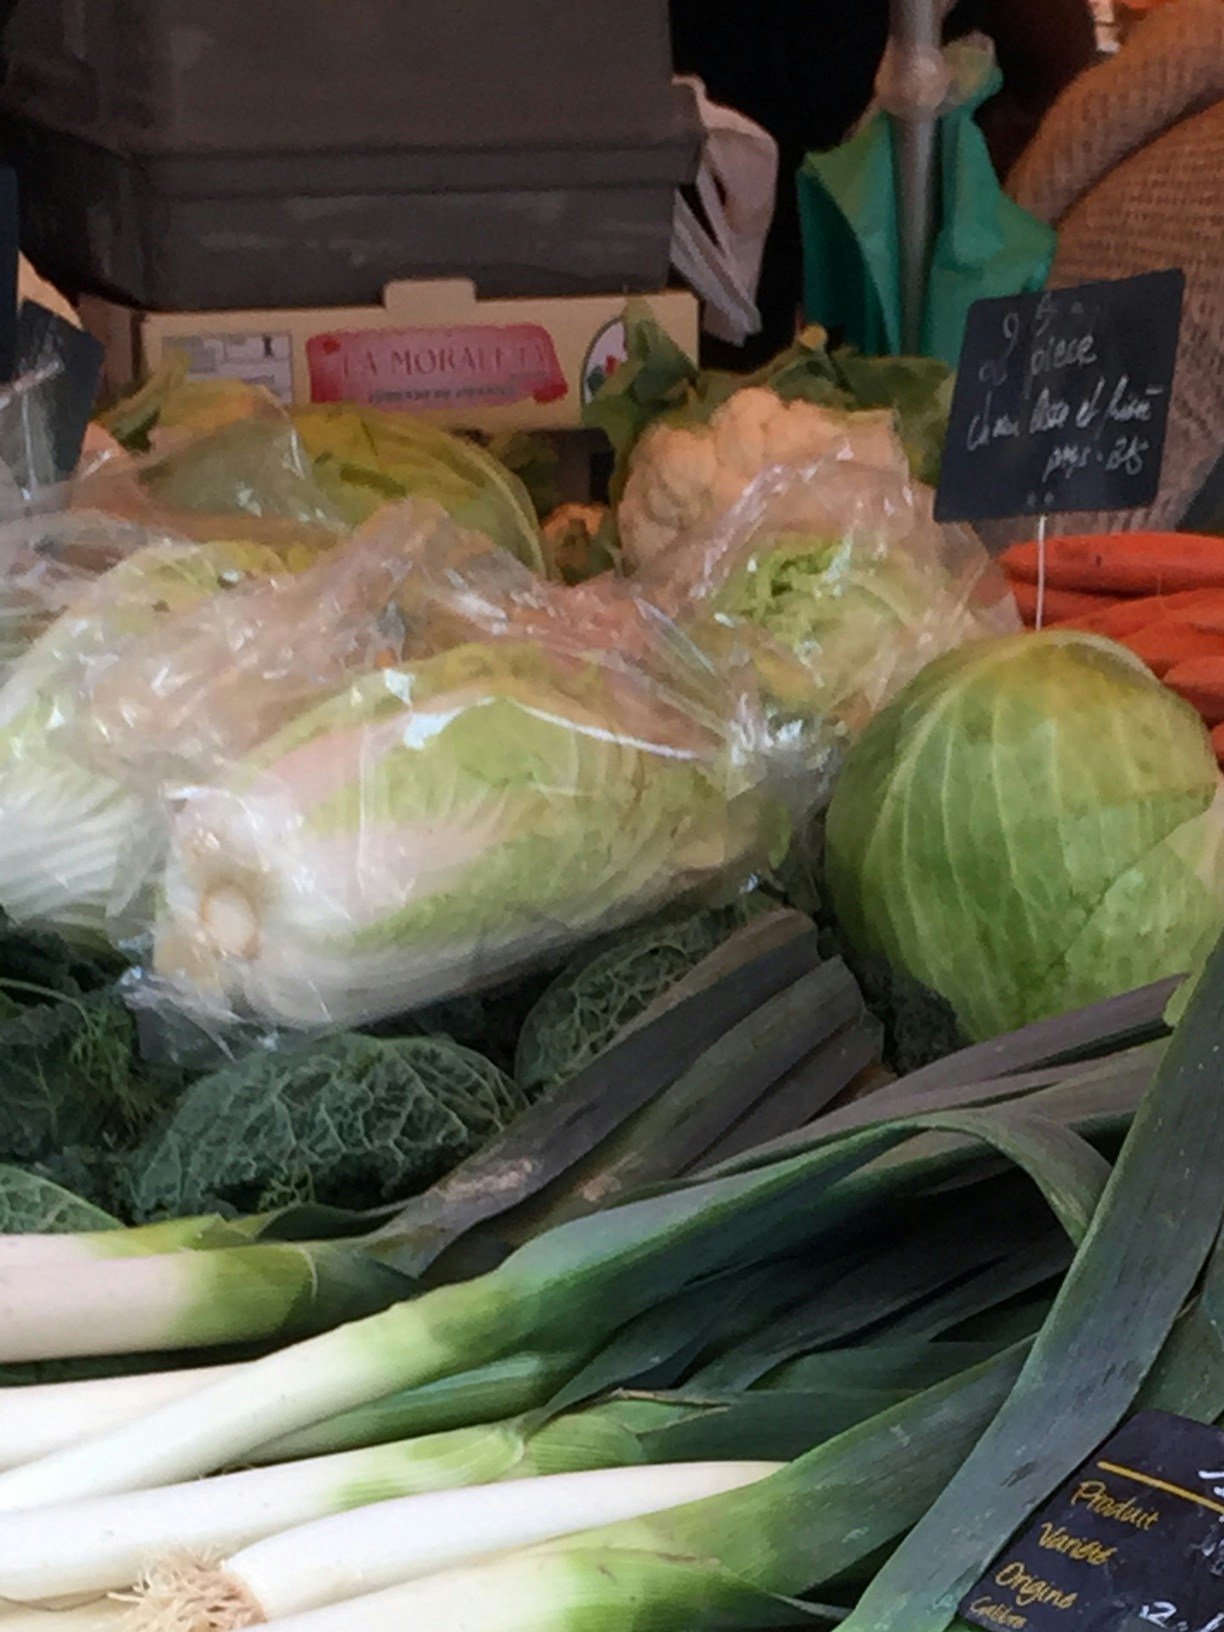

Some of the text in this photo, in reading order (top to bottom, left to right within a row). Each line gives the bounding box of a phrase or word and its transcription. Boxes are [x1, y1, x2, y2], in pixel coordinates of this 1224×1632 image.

[1070, 1480, 1159, 1531] Produit
[994, 1561, 1079, 1610] Origine
[969, 1595, 1030, 1630] Calibre
